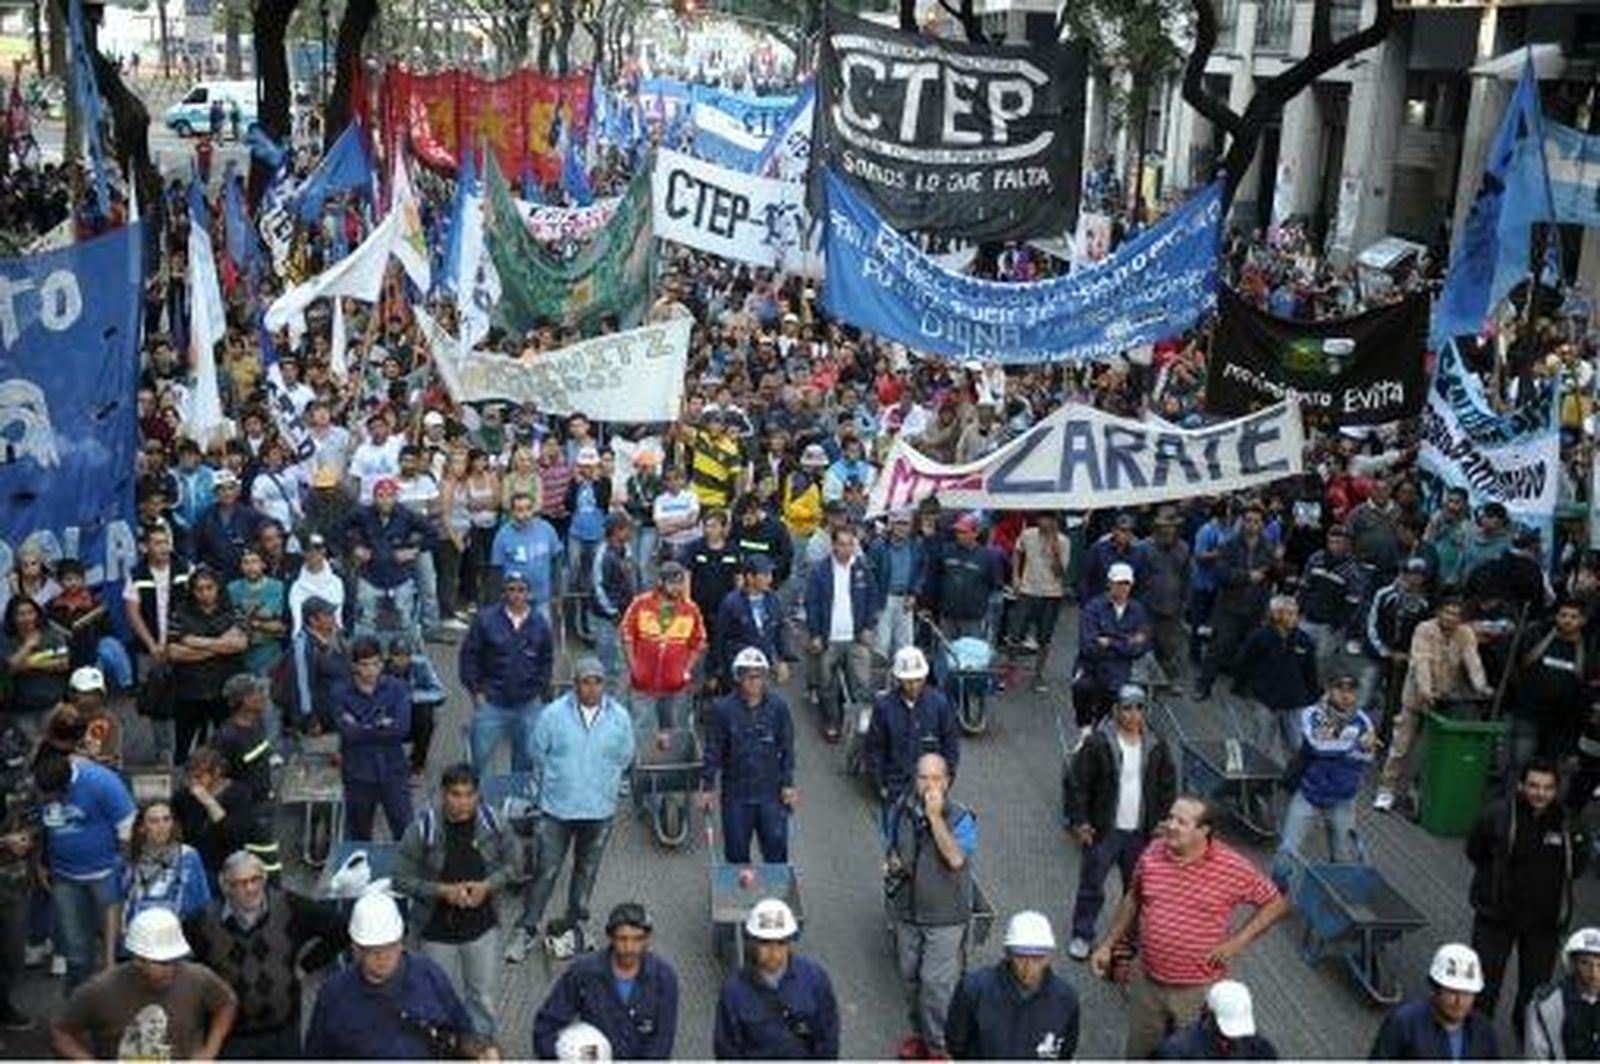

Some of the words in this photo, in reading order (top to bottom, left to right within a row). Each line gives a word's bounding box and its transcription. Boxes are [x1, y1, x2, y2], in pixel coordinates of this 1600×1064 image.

[842, 53, 1034, 143] CTEP
[915, 174, 940, 192] LO
[986, 407, 1291, 495] ZARATE
